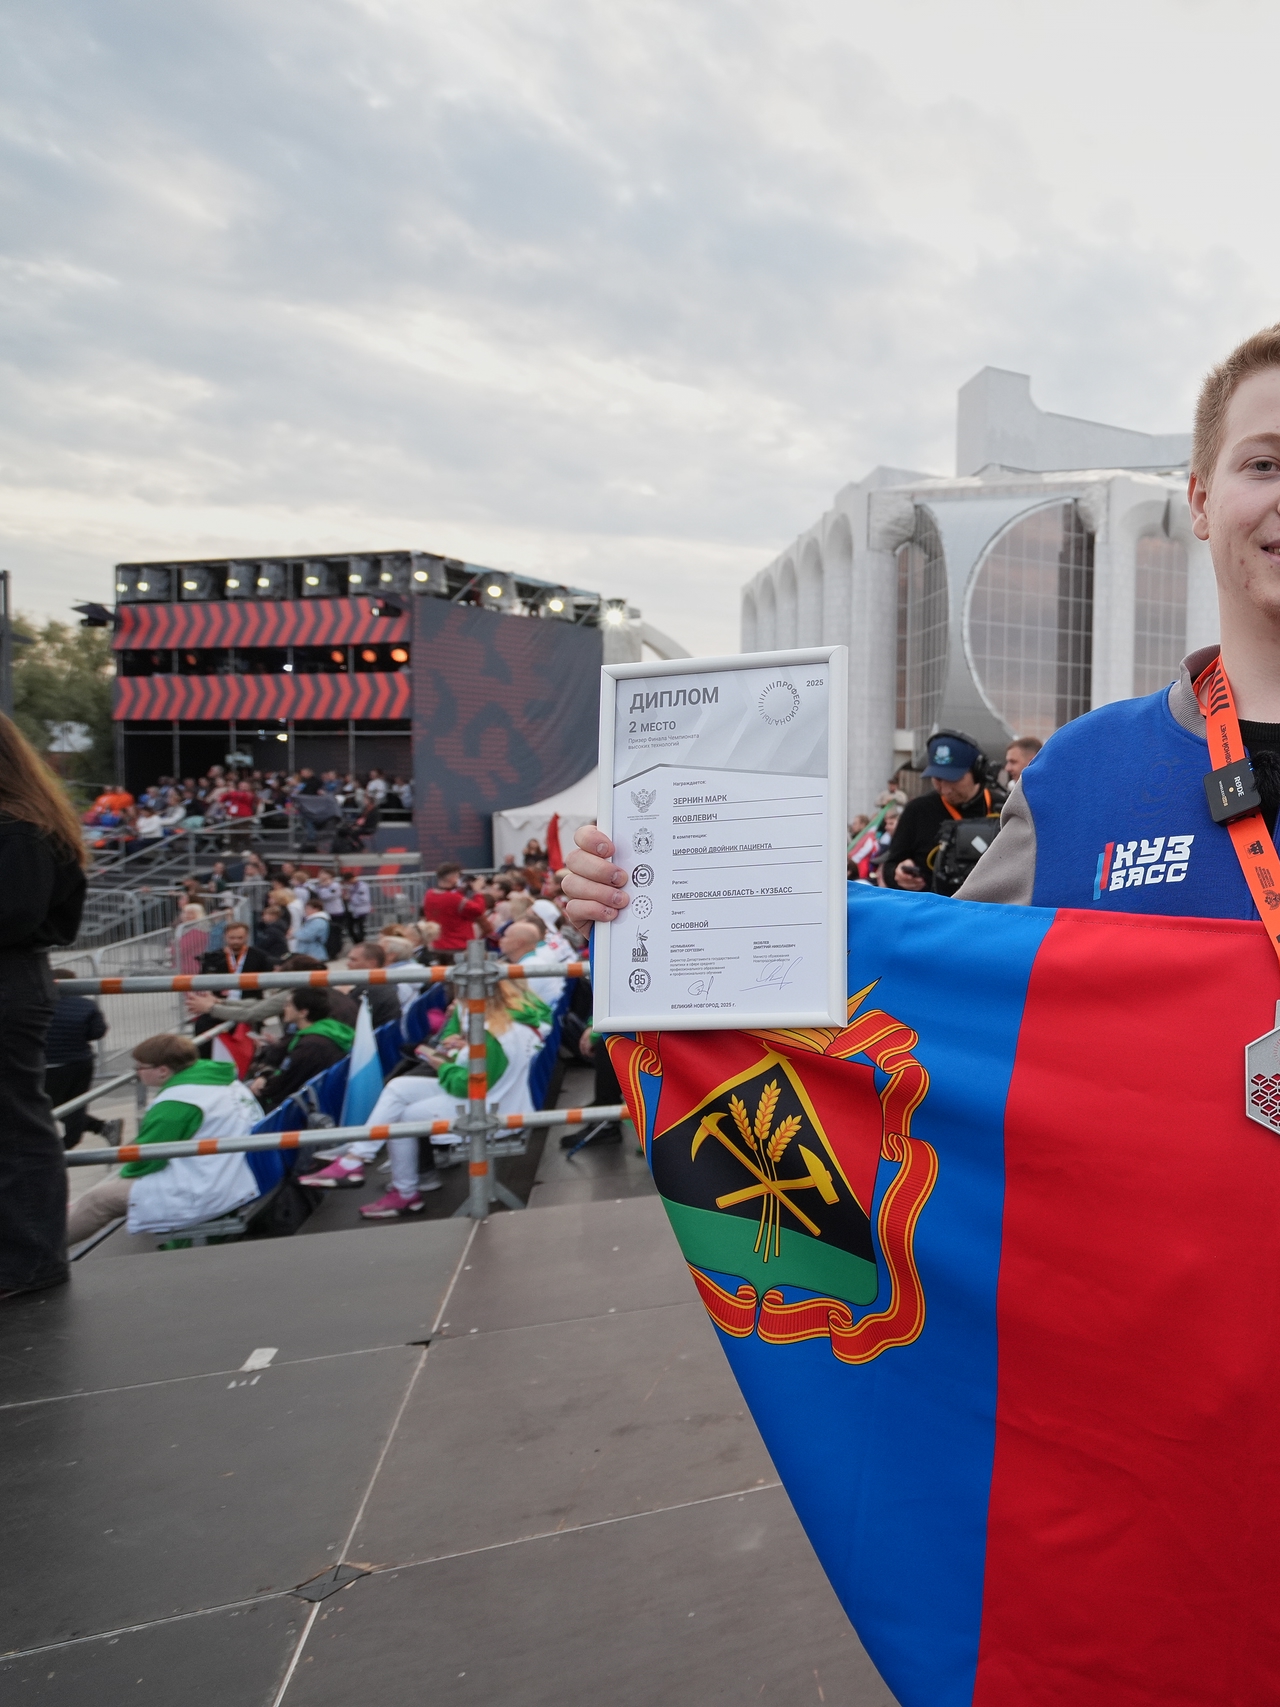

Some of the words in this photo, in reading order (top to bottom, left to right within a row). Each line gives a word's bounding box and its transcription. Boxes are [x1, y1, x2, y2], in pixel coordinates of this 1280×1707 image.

[806, 678, 824, 687] 2025
[629, 686, 719, 714] ДИПЛОМ
[759, 680, 800, 726] ПРОФЕССИОНАЛЫ
[628, 720, 637, 734] 2
[640, 720, 676, 732] МЕСТО
[1220, 724, 1228, 742] ЗАЧЕТ
[650, 740, 680, 748] технологий
[673, 796, 704, 805] ЗЕРНИН
[704, 794, 728, 803] МАРК
[672, 813, 718, 823] ЯКОВЛЕВИЧ
[672, 845, 708, 855] ЦИФРОВОЙ
[708, 844, 738, 854] ДВОЙНИК
[739, 843, 772, 852] ПАЦИЕНТА
[1112, 834, 1195, 870] КУЗ
[1108, 862, 1189, 892] БАСС
[672, 891, 721, 900] КЕМЕРОВСКАЯ
[722, 888, 755, 897] ОБЛАСТЬ
[760, 886, 793, 895] КУЗБАСС
[671, 920, 709, 930] ОСНОВНОЙ
[634, 974, 646, 985] 85
